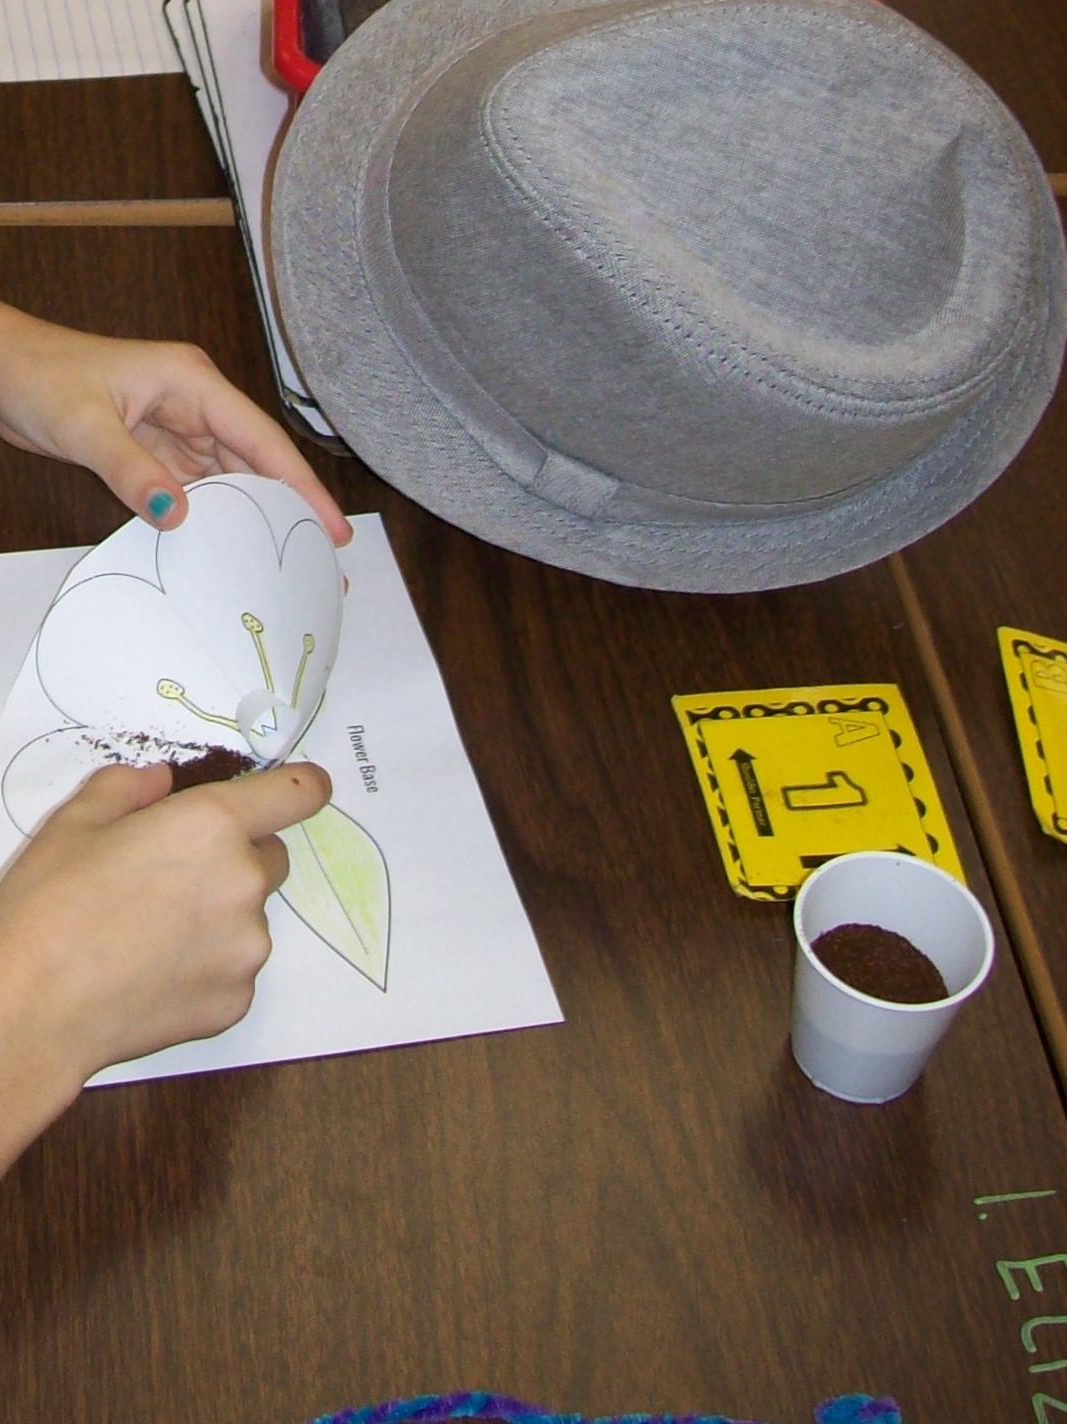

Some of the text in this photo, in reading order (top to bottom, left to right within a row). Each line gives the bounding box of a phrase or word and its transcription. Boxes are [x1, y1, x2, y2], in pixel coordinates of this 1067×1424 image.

[827, 716, 881, 748] A
[347, 725, 379, 794] Flower Base
[781, 770, 869, 811] 1
[751, 796, 766, 827] Partner
